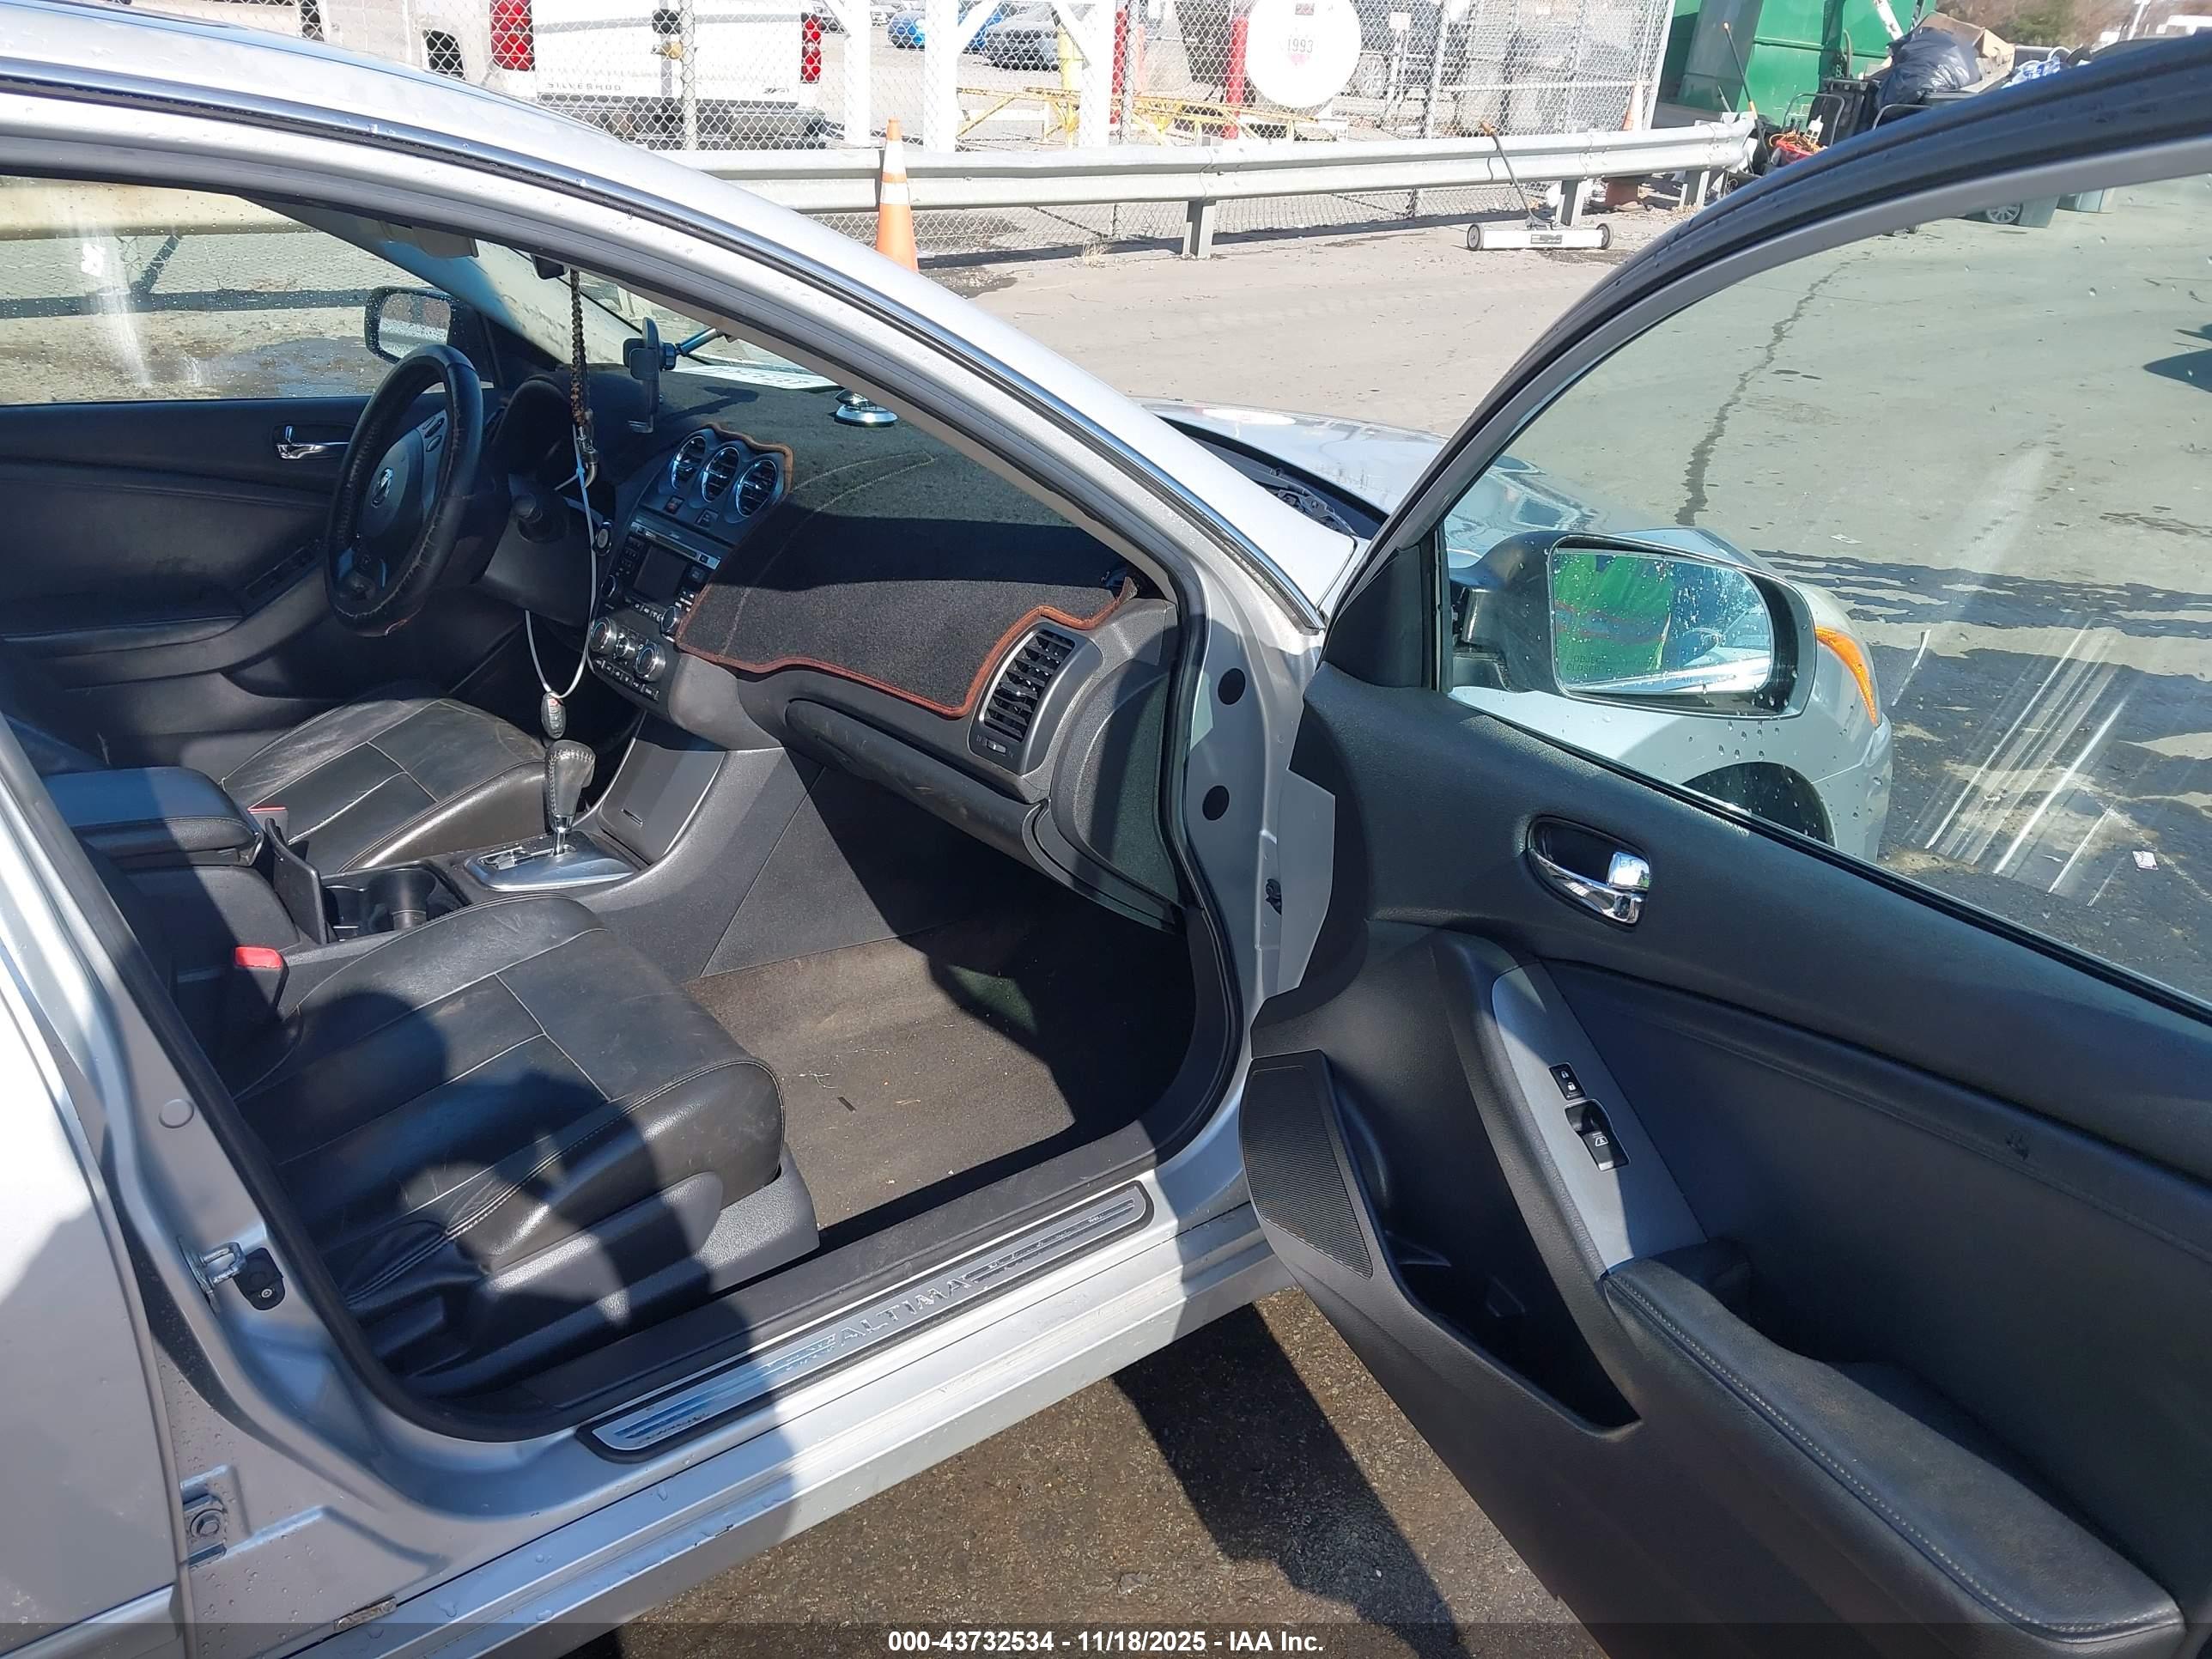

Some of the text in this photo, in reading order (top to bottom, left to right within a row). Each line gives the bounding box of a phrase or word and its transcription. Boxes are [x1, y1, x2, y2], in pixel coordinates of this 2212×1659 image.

[1287, 38, 1314, 53] 1993
[1573, 654, 1611, 666] OBJEC
[841, 1278, 973, 1347] ALTIMA
